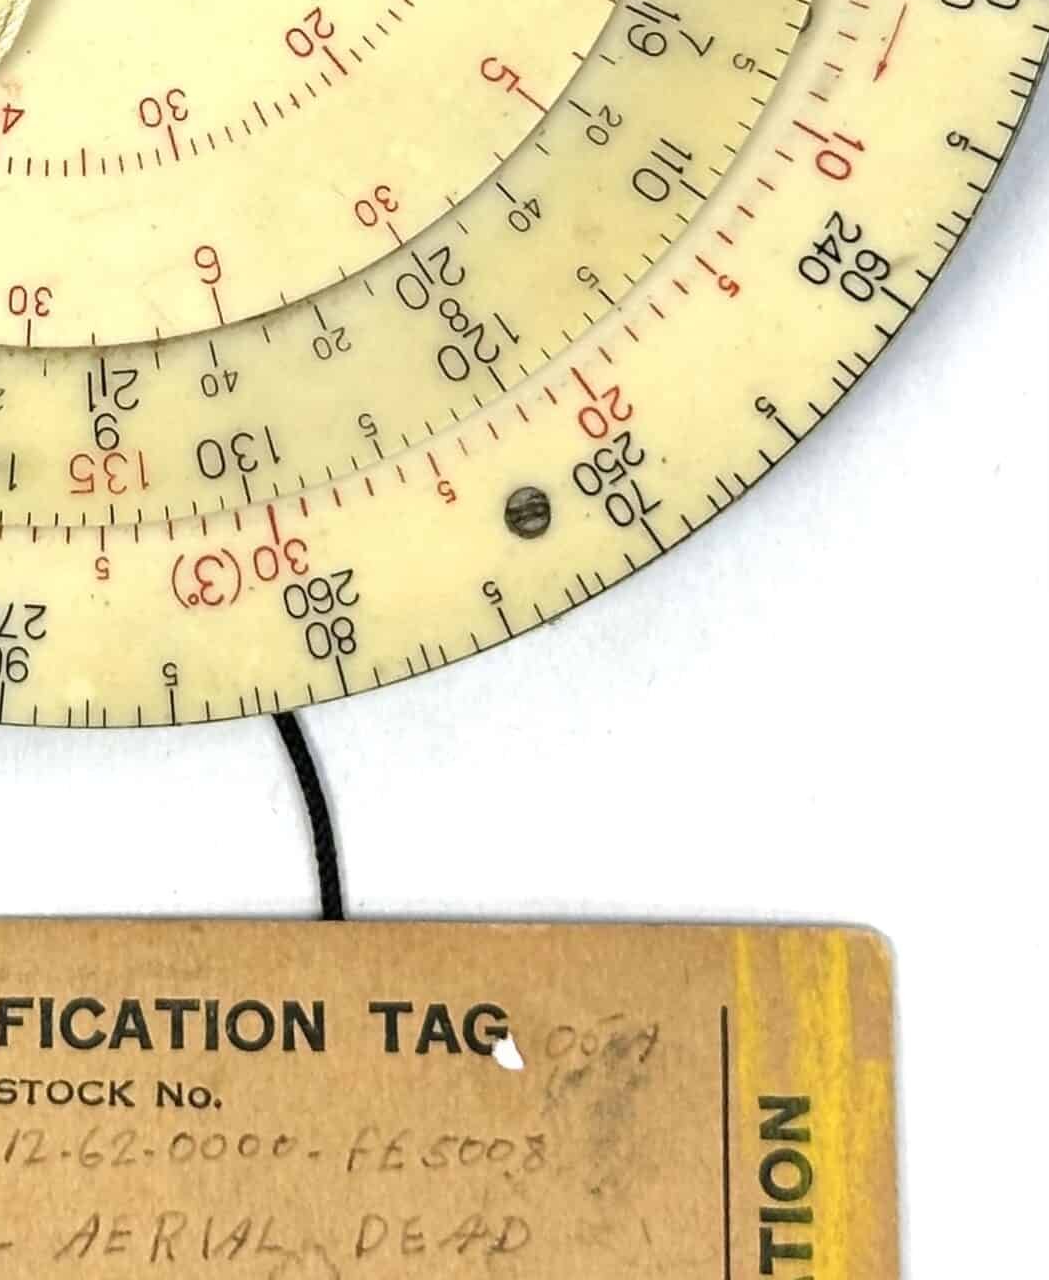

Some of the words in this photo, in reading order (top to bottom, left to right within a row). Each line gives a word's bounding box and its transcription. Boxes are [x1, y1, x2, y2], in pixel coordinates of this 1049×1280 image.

[285, 7, 334, 58] 20
[680, 29, 714, 55] 7
[480, 57, 520, 92] 5
[139, 88, 188, 128] 30
[632, 138, 692, 202] 110
[815, 132, 864, 181] 10
[355, 186, 398, 227] 30
[195, 246, 221, 284] 6
[798, 211, 862, 285] 240
[576, 266, 599, 289] 5
[841, 249, 891, 302] 60
[313, 327, 352, 359] 20
[438, 313, 519, 381] 120
[578, 386, 633, 440] 20
[70, 450, 150, 495] 135
[197, 425, 281, 478] 130
[573, 432, 644, 496] 250
[605, 480, 662, 527] 70
[95, 557, 109, 580] 5
[284, 570, 359, 619] 260
[483, 581, 502, 604] 5
[306, 617, 356, 659] 80
[368, 1000, 511, 1056] TAG
[156, 1082, 223, 1110] No.
[757, 1095, 814, 1280] TION
[356, 1213, 531, 1258] DEAD
